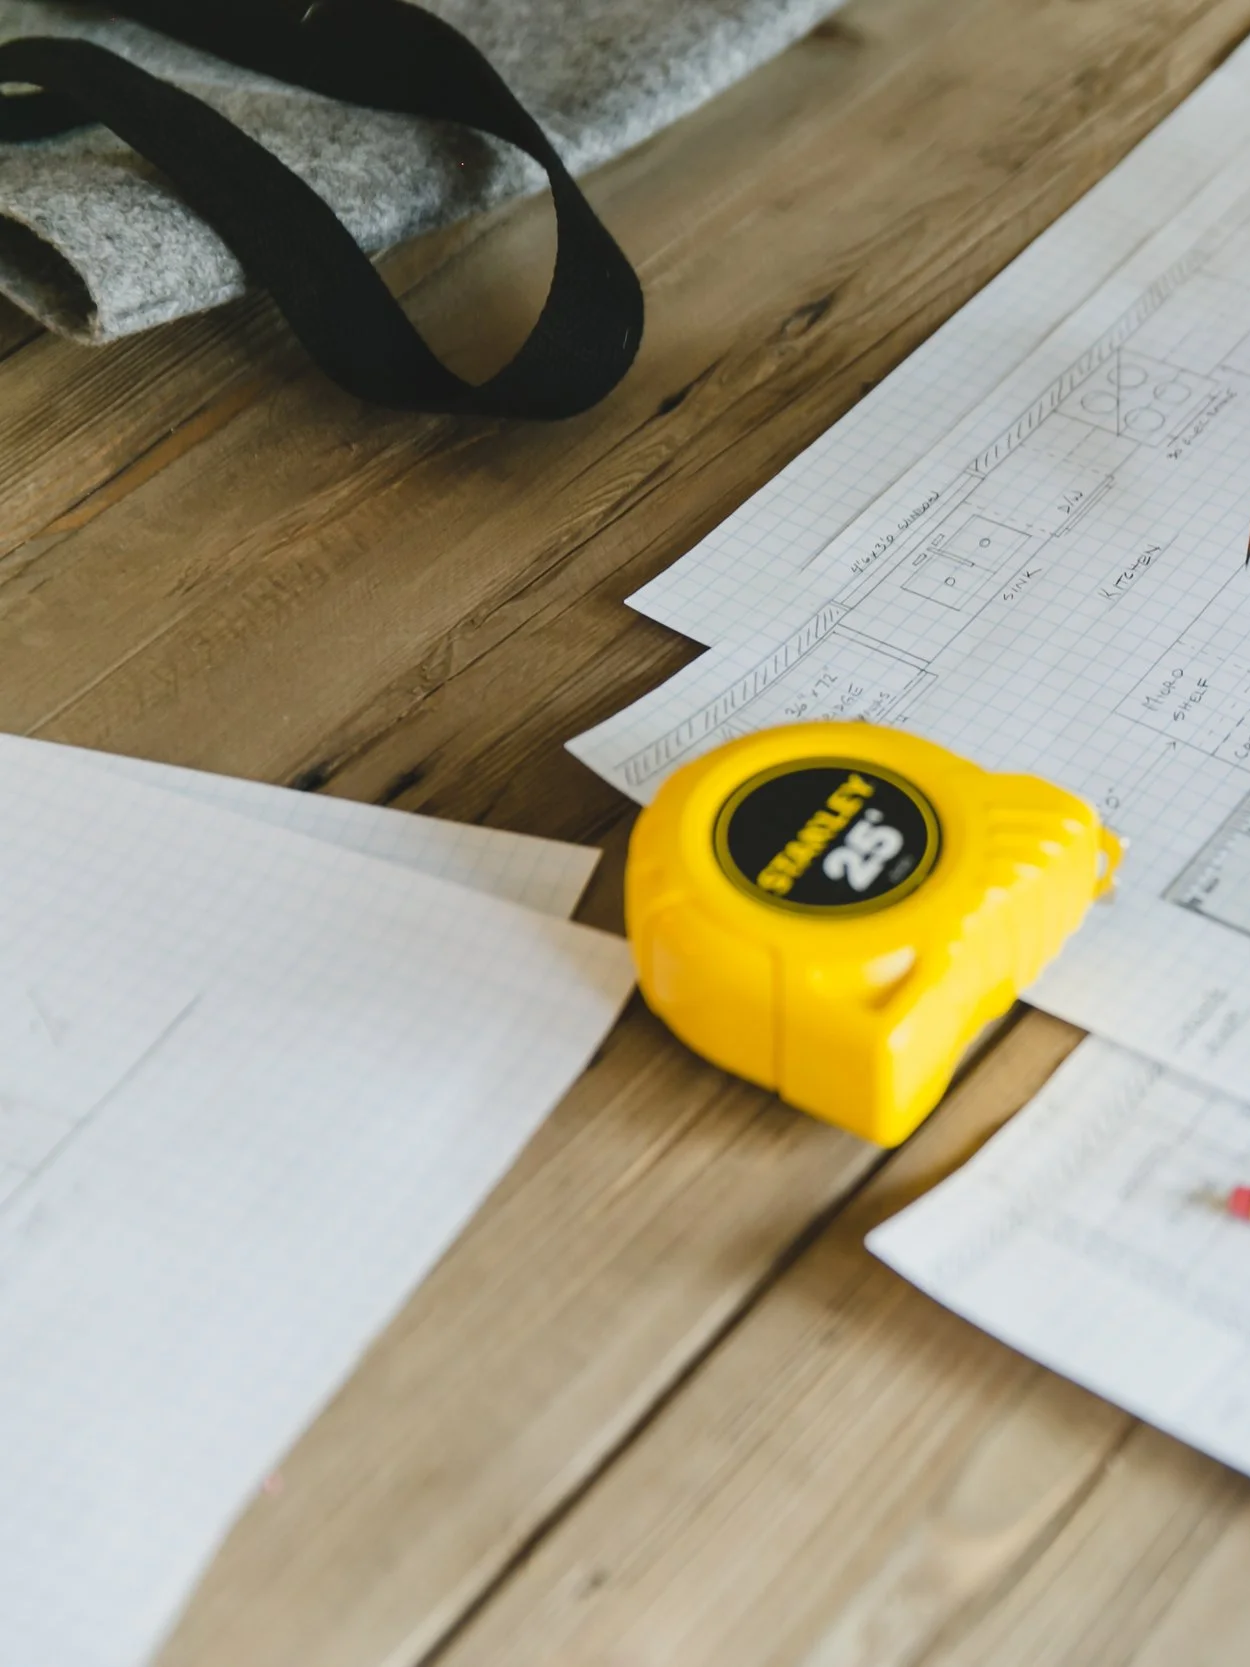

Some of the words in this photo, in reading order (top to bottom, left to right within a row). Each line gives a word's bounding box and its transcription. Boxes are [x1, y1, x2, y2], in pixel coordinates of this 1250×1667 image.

[1003, 568, 1042, 601] SINK
[1097, 544, 1161, 601] KITCHEN
[1141, 668, 1184, 712] MICRO
[1173, 678, 1209, 722] SHELF
[757, 773, 875, 896] STANLEY
